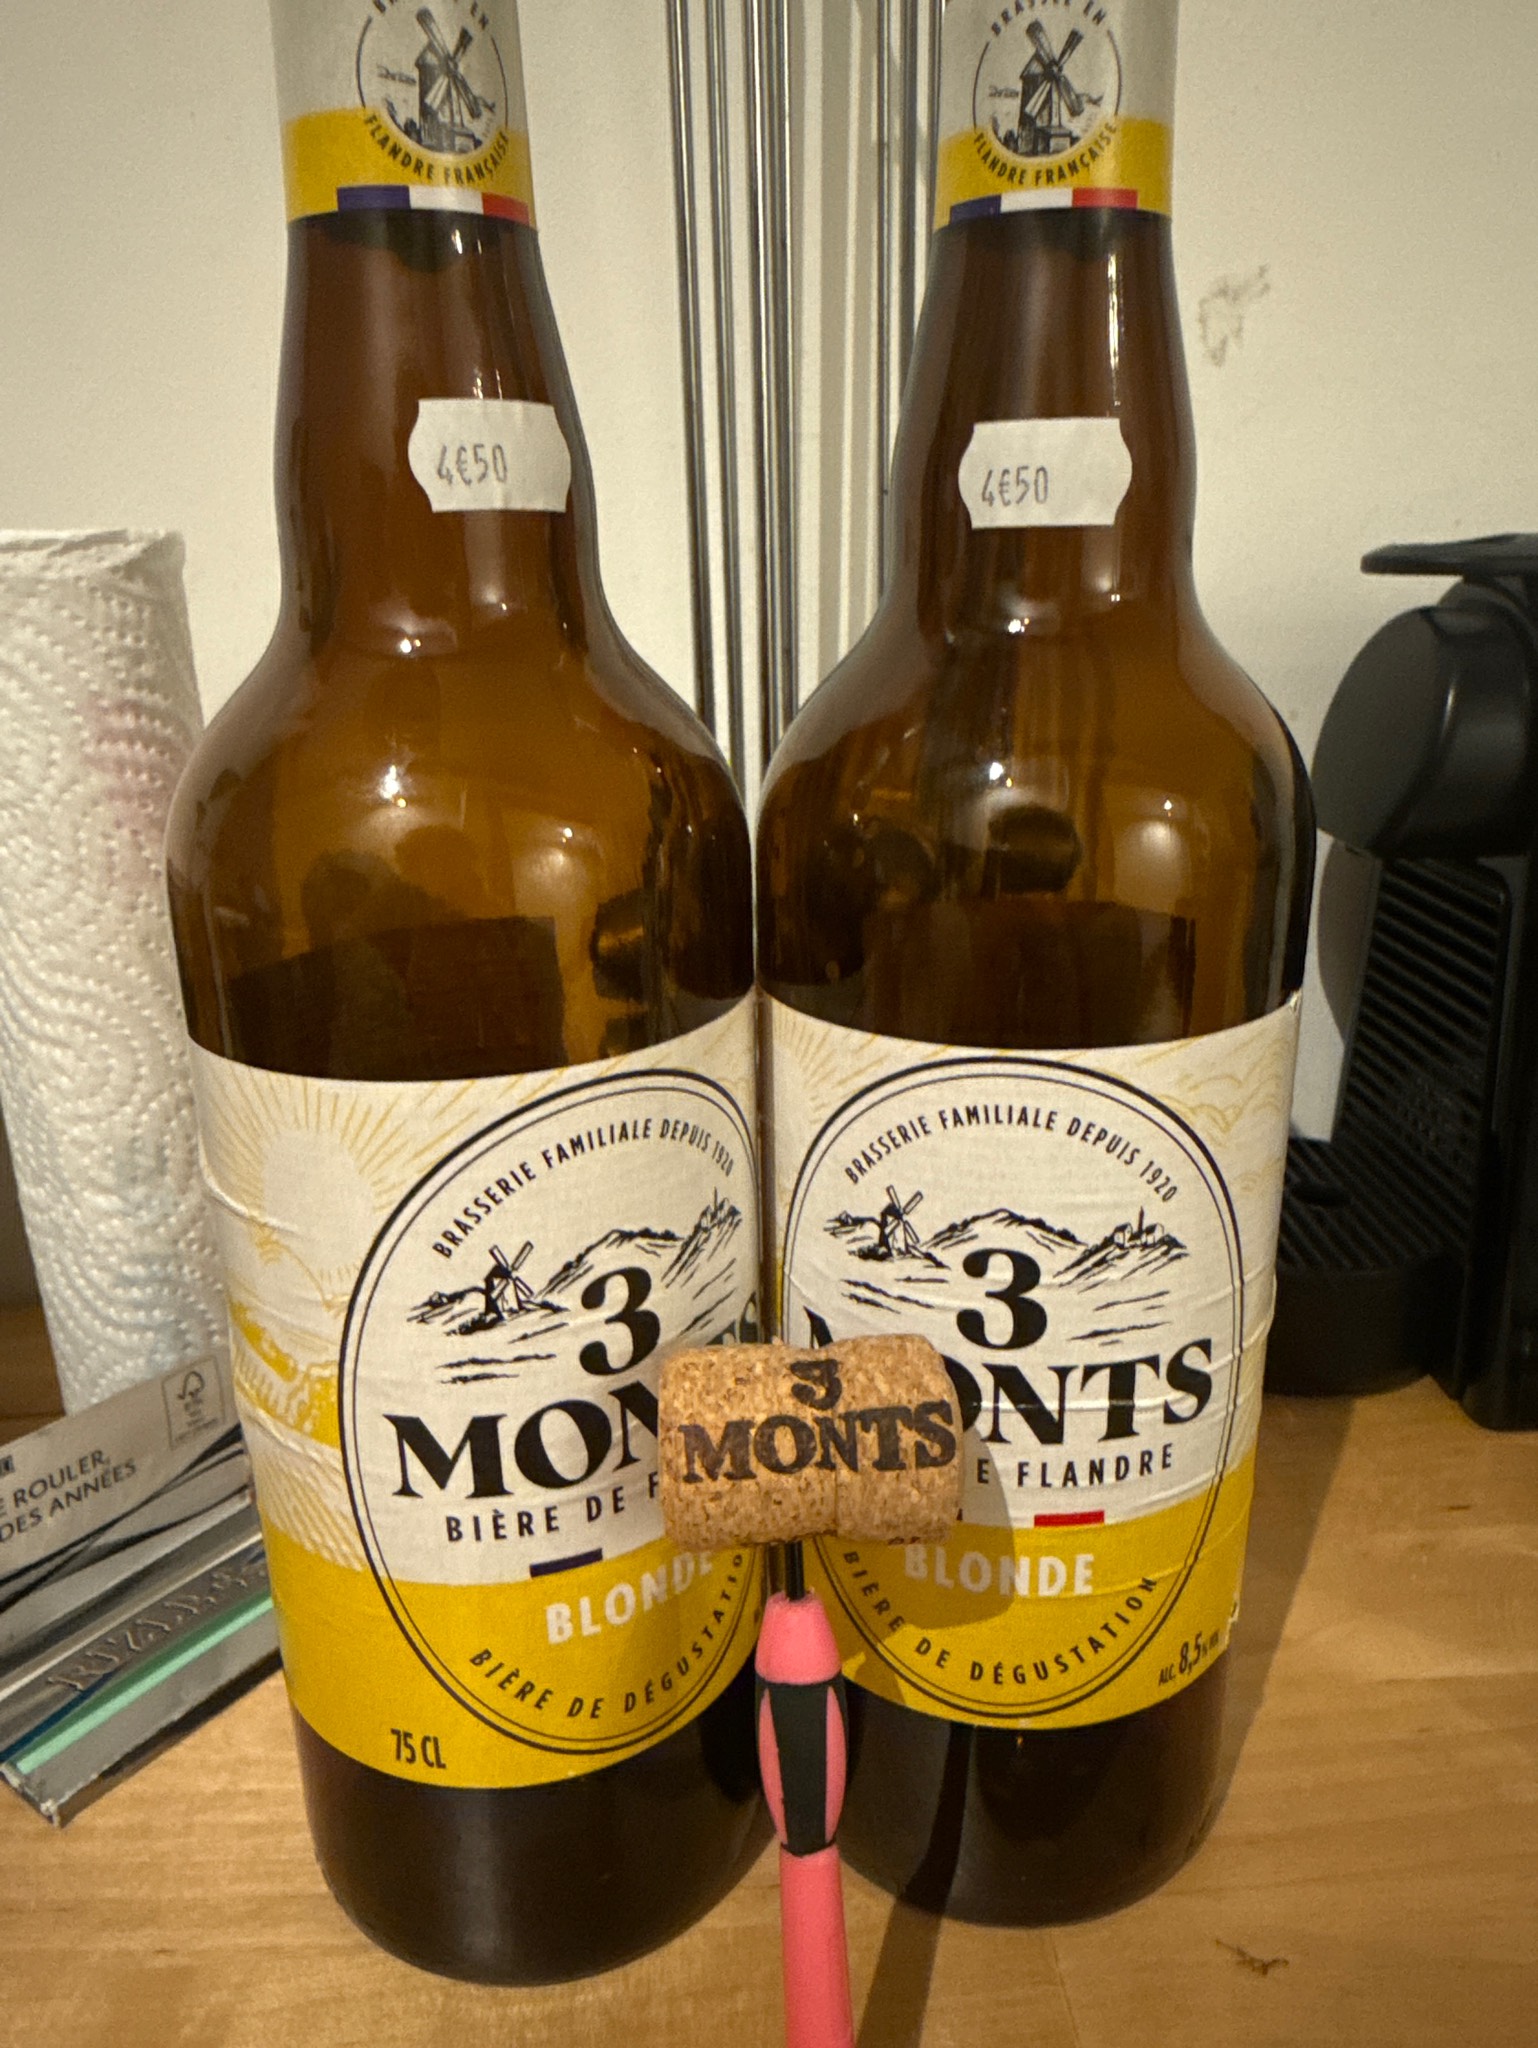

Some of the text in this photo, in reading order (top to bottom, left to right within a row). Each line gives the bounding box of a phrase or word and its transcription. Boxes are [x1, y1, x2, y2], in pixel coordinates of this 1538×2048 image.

[363, 113, 509, 185] FLANDRE FRANÇAISE
[973, 121, 1117, 186] FLANDRE FRANÇAISE
[437, 444, 508, 486] 4€50
[981, 465, 1049, 507] 4€50
[432, 1118, 736, 1260] BRASSERIE FAMILIALE DEPUIS 1920
[844, 1103, 1179, 1203] BRASSERIE FAMILIALE DEPUIS 1920
[579, 1265, 662, 1377] 3
[956, 1248, 1049, 1351] 3
[789, 1358, 843, 1411] 3
[942, 1337, 1214, 1446] NTS
[13, 1449, 106, 1508] ROULER
[382, 1380, 659, 1500] MON
[677, 1399, 957, 1484] MONTS
[1017, 1442, 1174, 1489] FLANDRE
[0, 1458, 137, 1543] DES ANNÉES
[445, 1486, 626, 1543] BIÈRE DE
[544, 1549, 714, 1646] BLONDE
[904, 1543, 1096, 1598] BLONDE
[469, 1554, 744, 1719] BIÈRE DE DÉGUSTATIO
[914, 1636, 950, 1669] DE
[969, 1575, 1158, 1685] DÉGUSTATION
[390, 1727, 447, 1769] 75 CL
